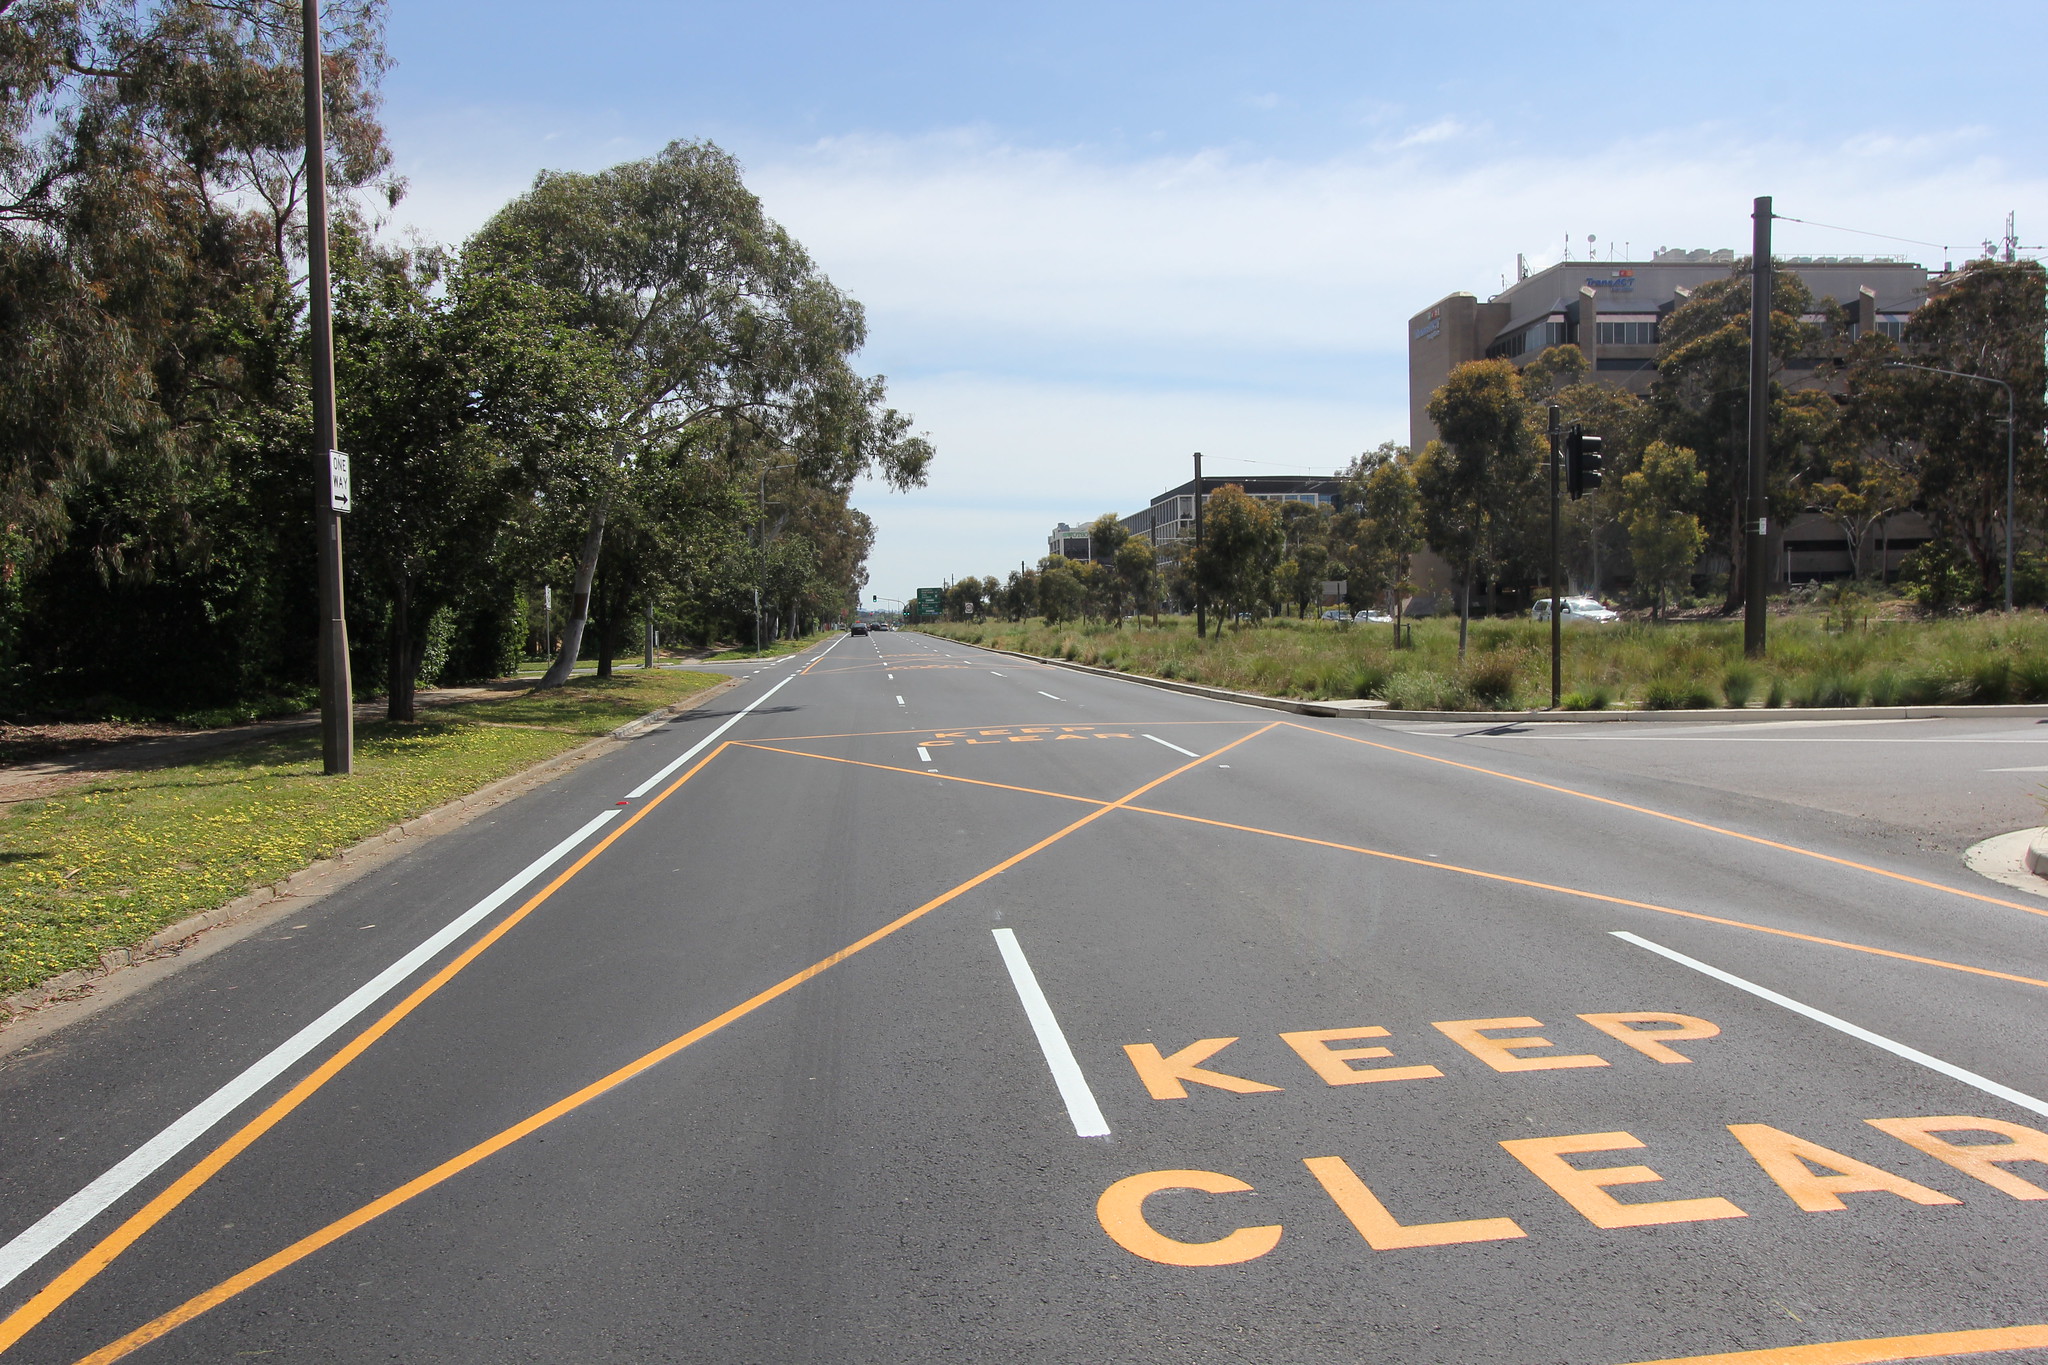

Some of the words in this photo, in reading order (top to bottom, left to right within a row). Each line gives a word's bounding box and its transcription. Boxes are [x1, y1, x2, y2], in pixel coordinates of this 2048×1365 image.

[333, 457, 346, 472] ONE
[333, 475, 348, 489] WAY
[933, 726, 1096, 739] KEEP
[917, 733, 1135, 747] CLEAR
[1122, 1011, 1721, 1100] KEEP
[1095, 1115, 2048, 1268] CLEAR
